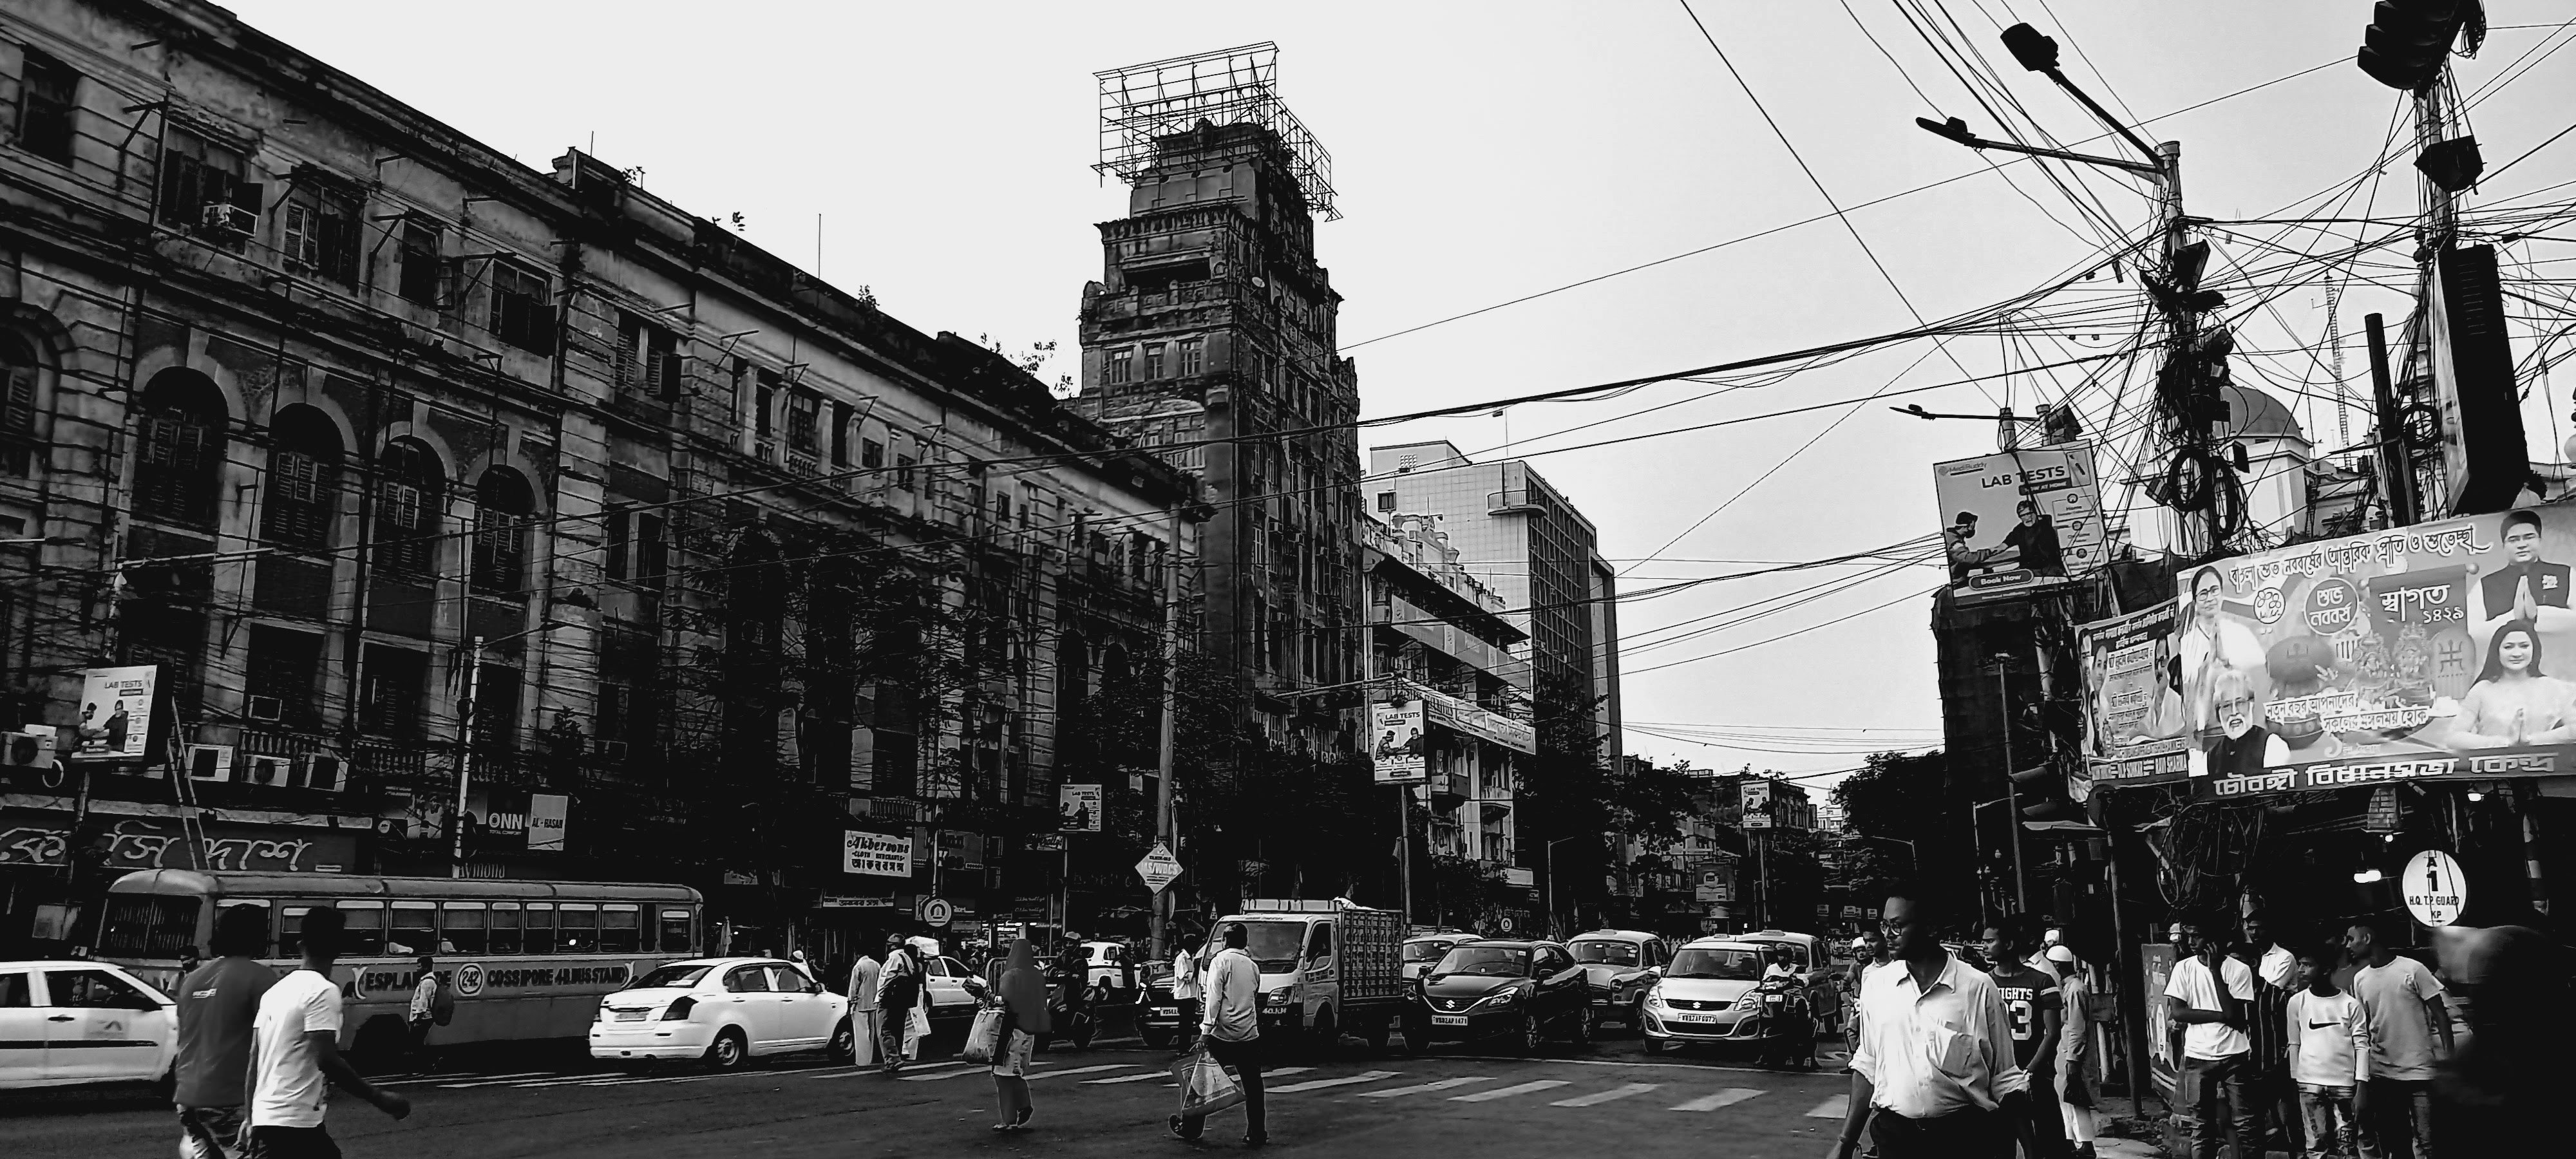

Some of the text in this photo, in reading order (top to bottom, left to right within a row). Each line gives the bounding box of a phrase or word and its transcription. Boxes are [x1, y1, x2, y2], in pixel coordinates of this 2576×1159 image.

[1982, 466, 2065, 489] LAB TESTS
[2231, 525, 2492, 592] বাংলা শুভ নববর্ষের আন্তরিক প্রীতি ও শুভেচ্ছা
[1981, 577, 2002, 585] Book
[2316, 585, 2344, 607] শুভ
[2380, 584, 2450, 622] স্বাগত
[2309, 602, 2353, 627] নববর্ষ
[2423, 606, 2465, 624] ১৪২৯
[120, 680, 142, 688] TESTS
[2265, 699, 2286, 721] নতুন
[2400, 706, 2428, 726] হোক
[2213, 767, 2298, 796] চৌরঙ্গী
[2306, 757, 2459, 787] বিধানসভা
[2468, 752, 2559, 775] কেন্দ্র
[489, 812, 523, 830] ONN
[2426, 856, 2438, 867] A
[2426, 870, 2439, 892] 1
[2436, 896, 2459, 906] GUARD
[365, 971, 452, 992] ESPLADE
[462, 970, 479, 988] 242
[487, 968, 554, 988] COSSIPORE
[1998, 986, 2033, 1001] IGHTS
